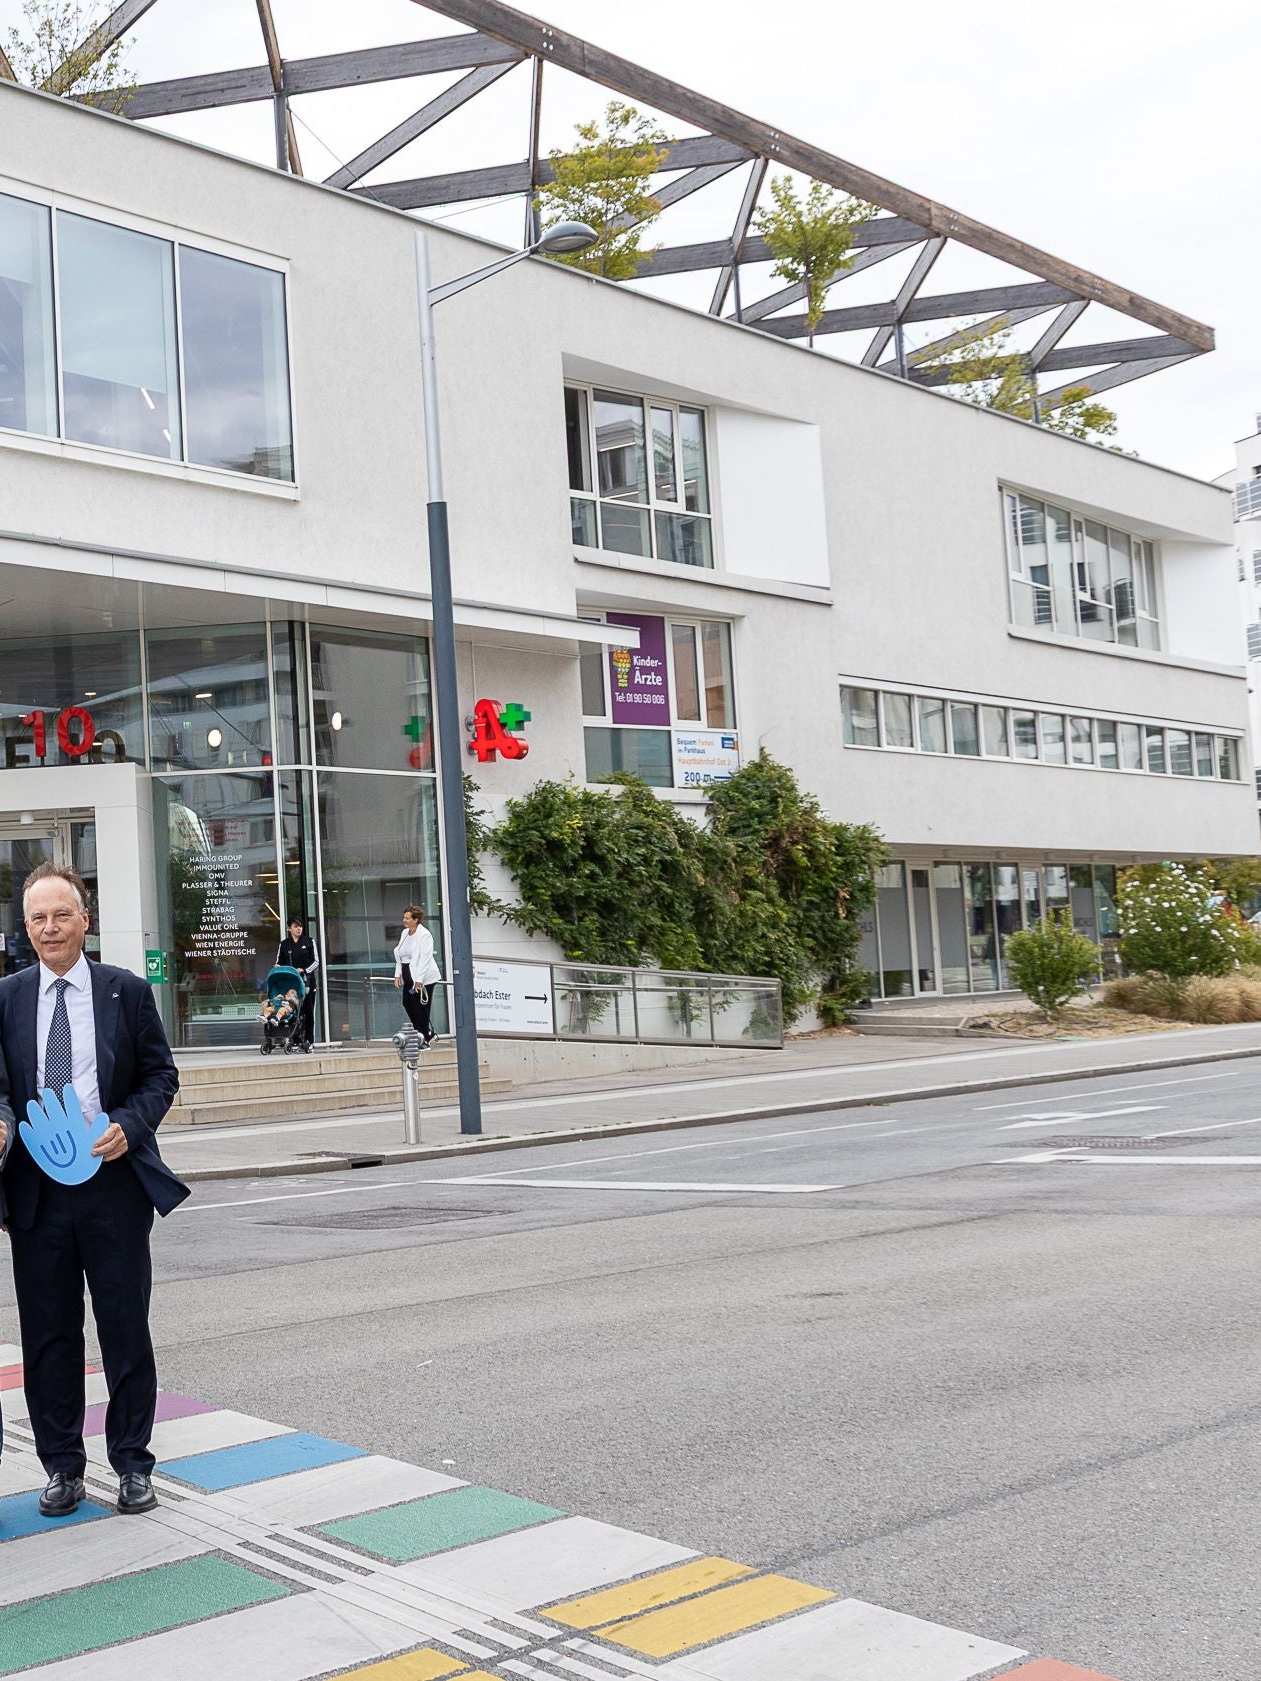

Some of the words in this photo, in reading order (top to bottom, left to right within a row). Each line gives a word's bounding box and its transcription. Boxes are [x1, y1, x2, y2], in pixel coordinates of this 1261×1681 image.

[633, 655, 662, 667] Kinder-
[634, 667, 663, 685] Ärzte
[626, 692, 633, 702] 01
[643, 693, 651, 704] 50
[22, 705, 96, 757] 10
[684, 771, 700, 782] 200
[189, 855, 217, 863] HARING
[193, 863, 239, 871] IMMOUNITED
[182, 881, 213, 889] PLASSER
[220, 879, 253, 887] THEURER
[202, 906, 235, 914] STRABAG
[201, 915, 236, 923] SYNTHOS
[199, 923, 222, 931] VALUE
[191, 931, 248, 940] VIENNA-GRUPPE
[214, 940, 245, 948] ENERGIE
[212, 948, 257, 957] STÄDTISCHE
[495, 990, 511, 1000] Ester
